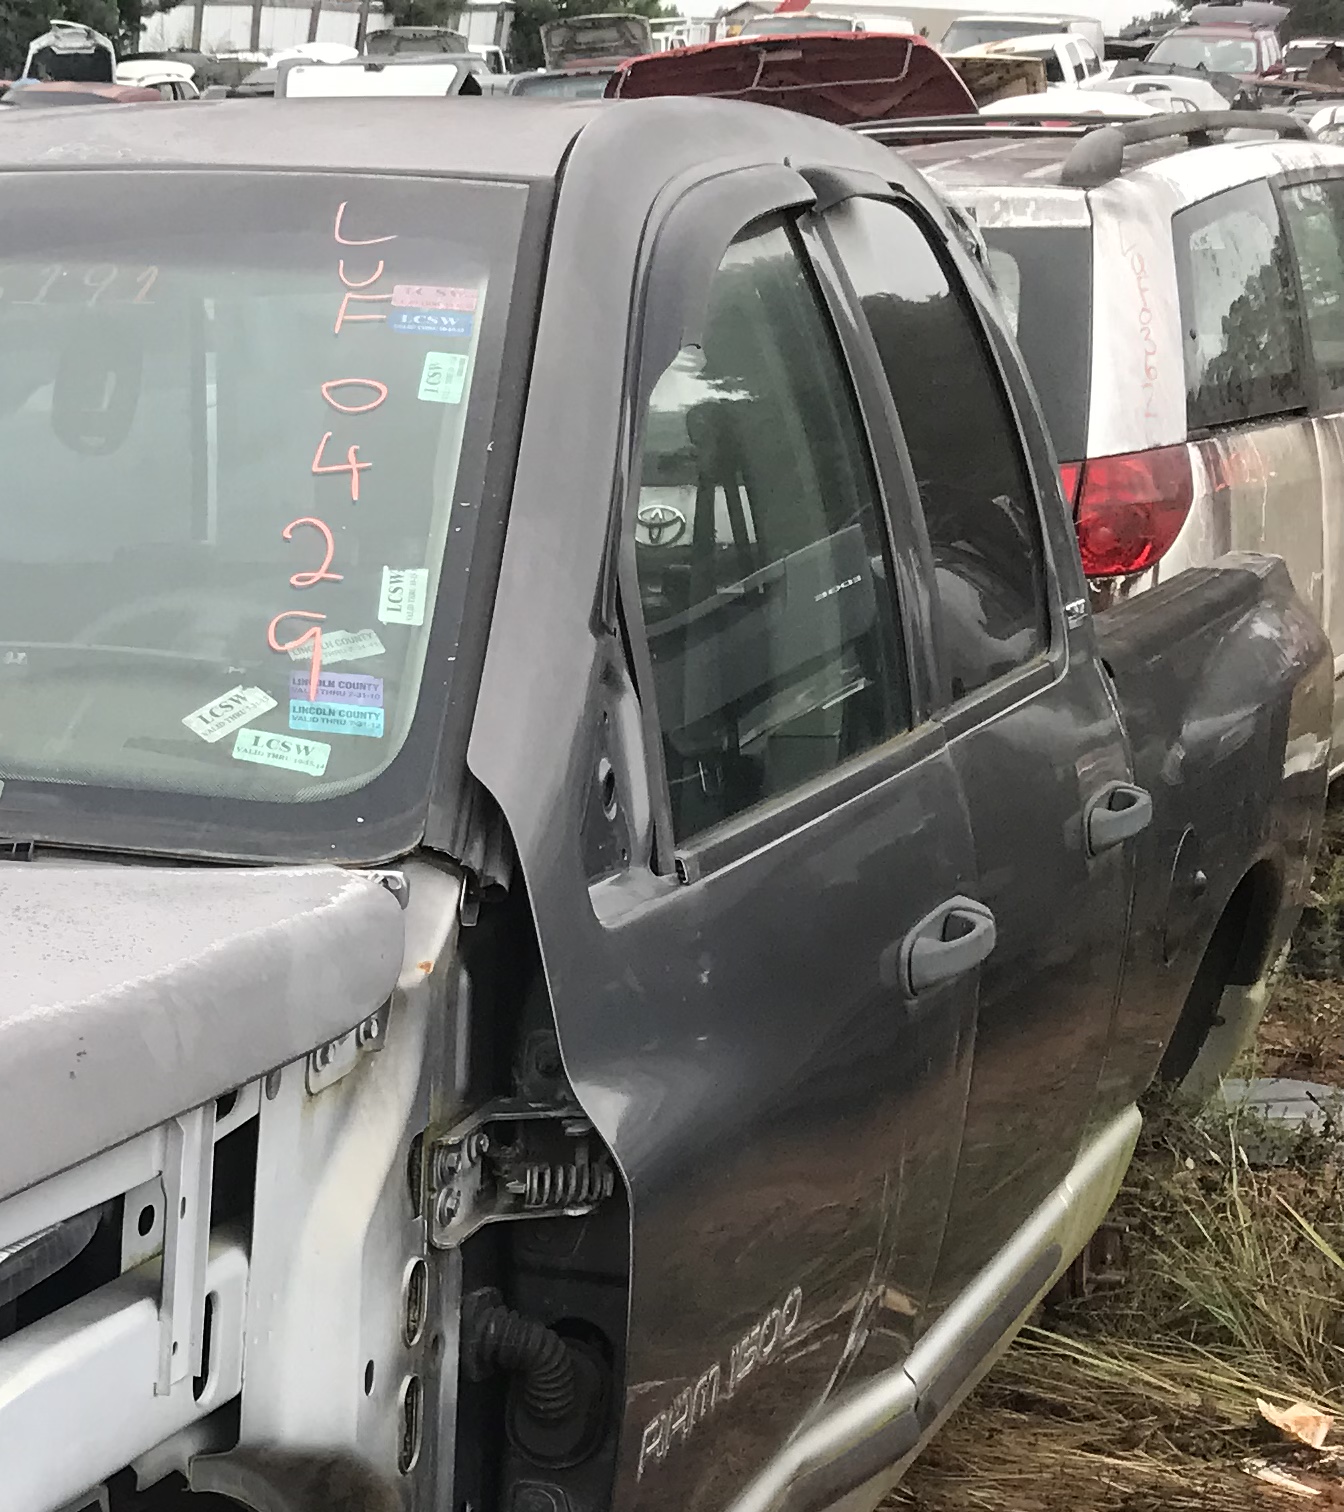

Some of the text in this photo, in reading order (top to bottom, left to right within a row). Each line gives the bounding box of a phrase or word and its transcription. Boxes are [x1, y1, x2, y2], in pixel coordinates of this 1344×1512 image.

[401, 314, 460, 326] LCSW
[386, 570, 405, 613] LCSW
[338, 680, 380, 692] COUNTY
[196, 690, 249, 726] LCSW
[292, 705, 382, 721] LINCOLN COUNTY
[320, 717, 347, 726] THRU
[252, 735, 316, 758] LCSW
[636, 1285, 803, 1484] RAM 1500
